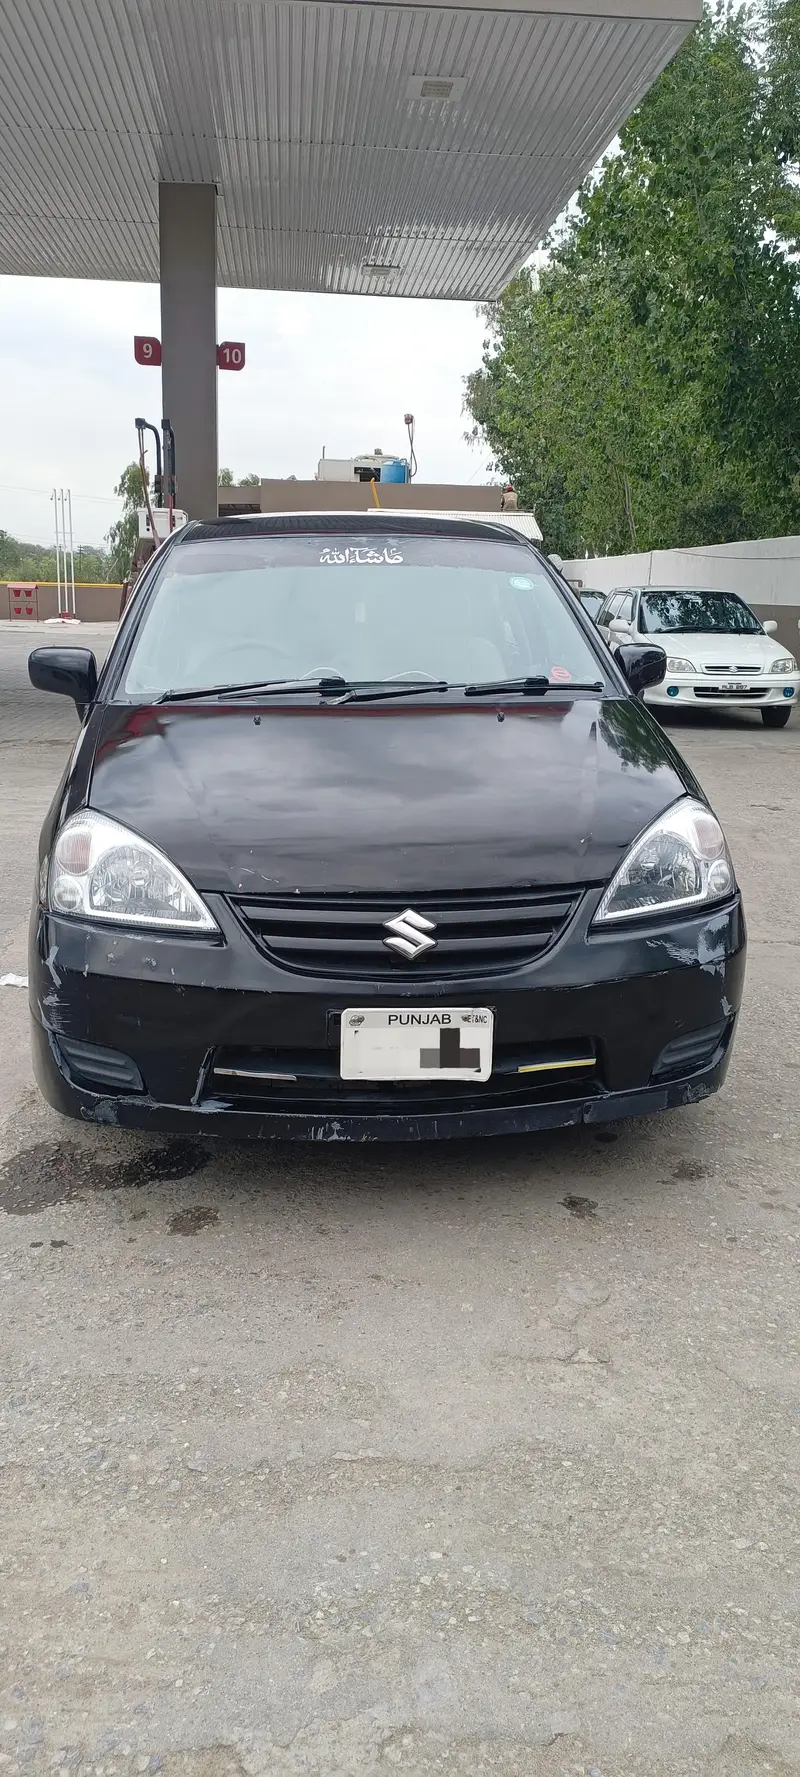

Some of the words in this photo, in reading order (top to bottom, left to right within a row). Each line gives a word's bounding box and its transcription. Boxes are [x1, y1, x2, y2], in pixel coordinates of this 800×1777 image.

[142, 343, 153, 359] 9
[222, 348, 242, 364] 10
[388, 1013, 452, 1025] PUNJAB
